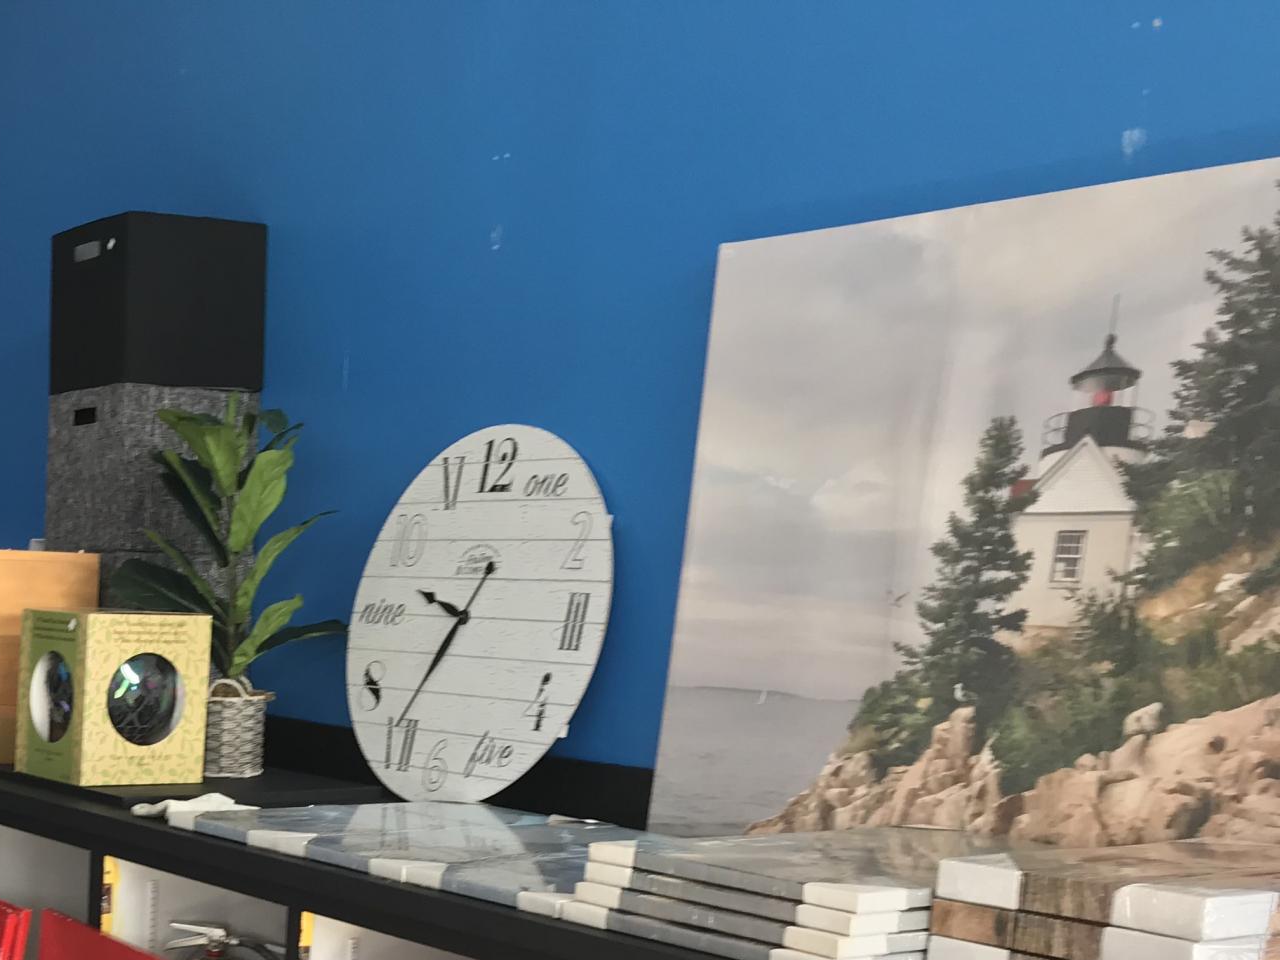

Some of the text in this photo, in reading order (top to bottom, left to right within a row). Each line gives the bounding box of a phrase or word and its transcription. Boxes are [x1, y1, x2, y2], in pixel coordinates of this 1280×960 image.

[478, 437, 519, 494] 12
[523, 472, 569, 498] one
[389, 512, 428, 568] 10
[560, 510, 594, 570] 2
[358, 598, 407, 627] nine
[557, 592, 591, 651] III
[359, 660, 387, 712] 8
[523, 672, 552, 732] 4
[421, 738, 448, 793] 6
[464, 730, 513, 779] five
